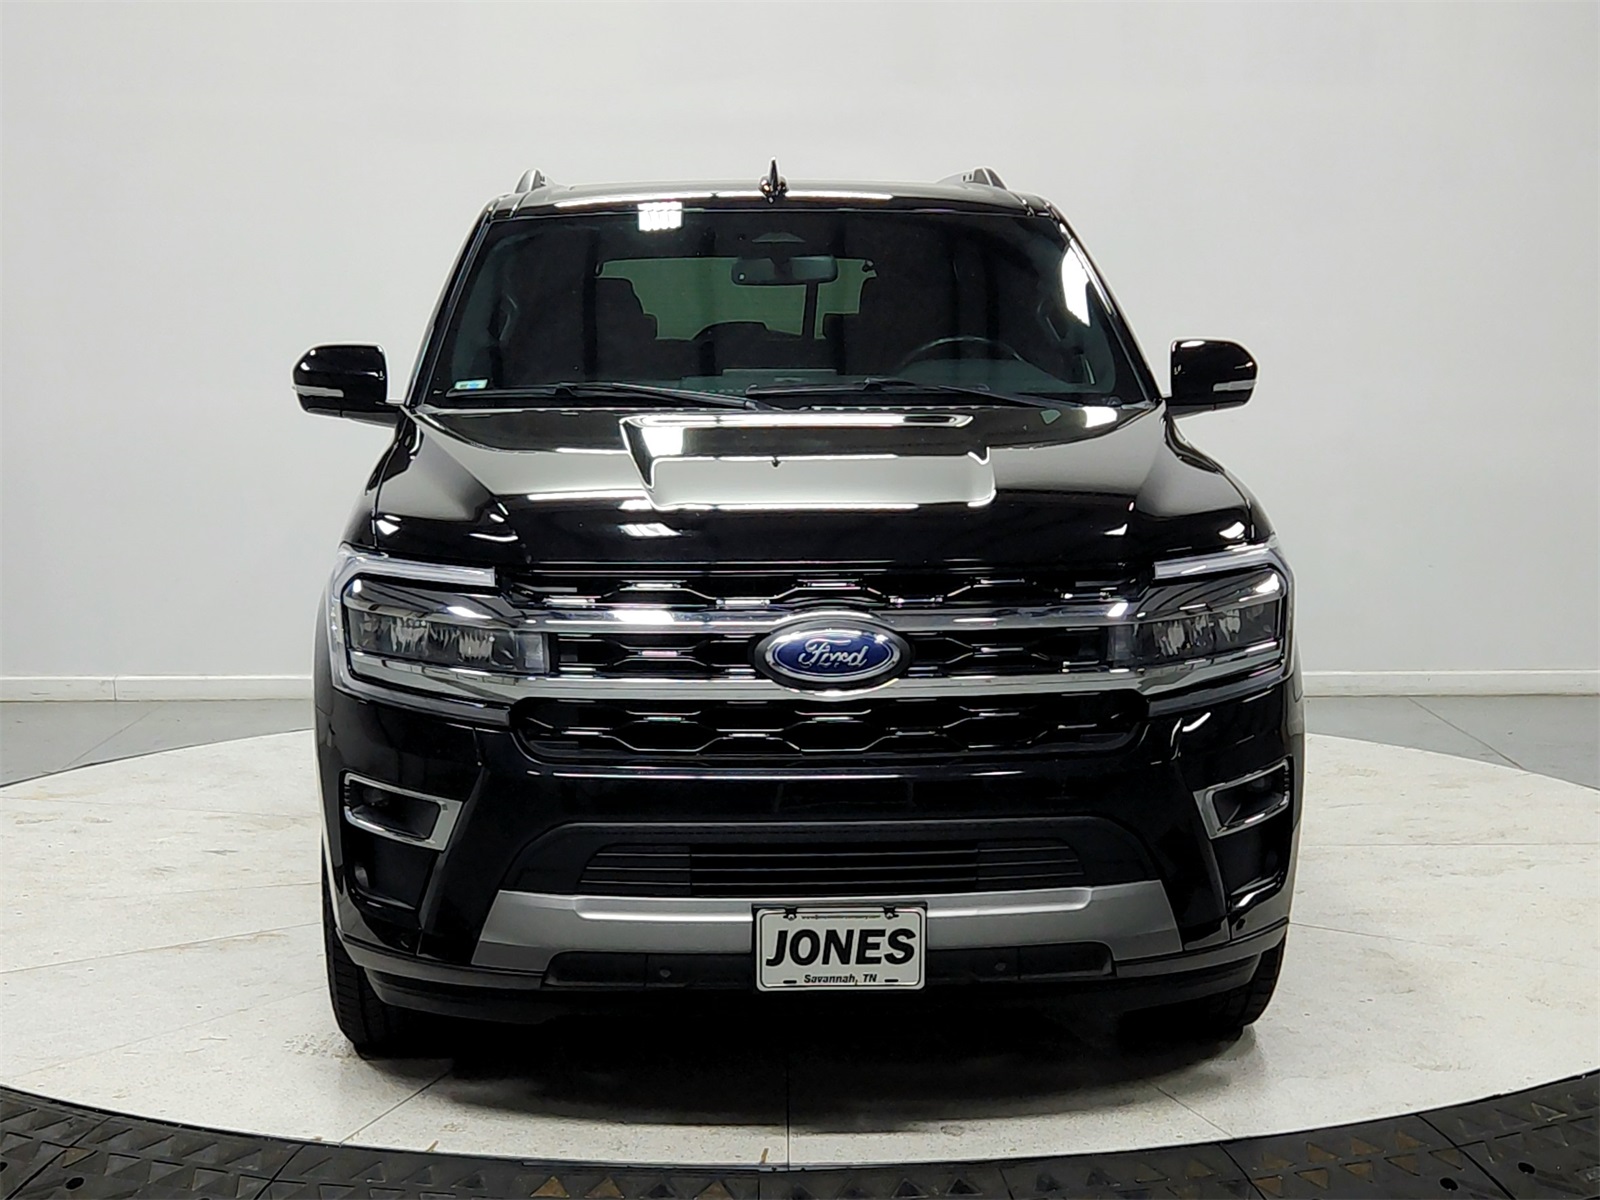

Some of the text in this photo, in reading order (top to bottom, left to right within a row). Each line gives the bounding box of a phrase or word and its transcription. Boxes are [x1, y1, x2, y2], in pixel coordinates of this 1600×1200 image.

[798, 638, 869, 668] Ford
[765, 928, 916, 967] JONES
[804, 973, 877, 986] Savannah, TN
